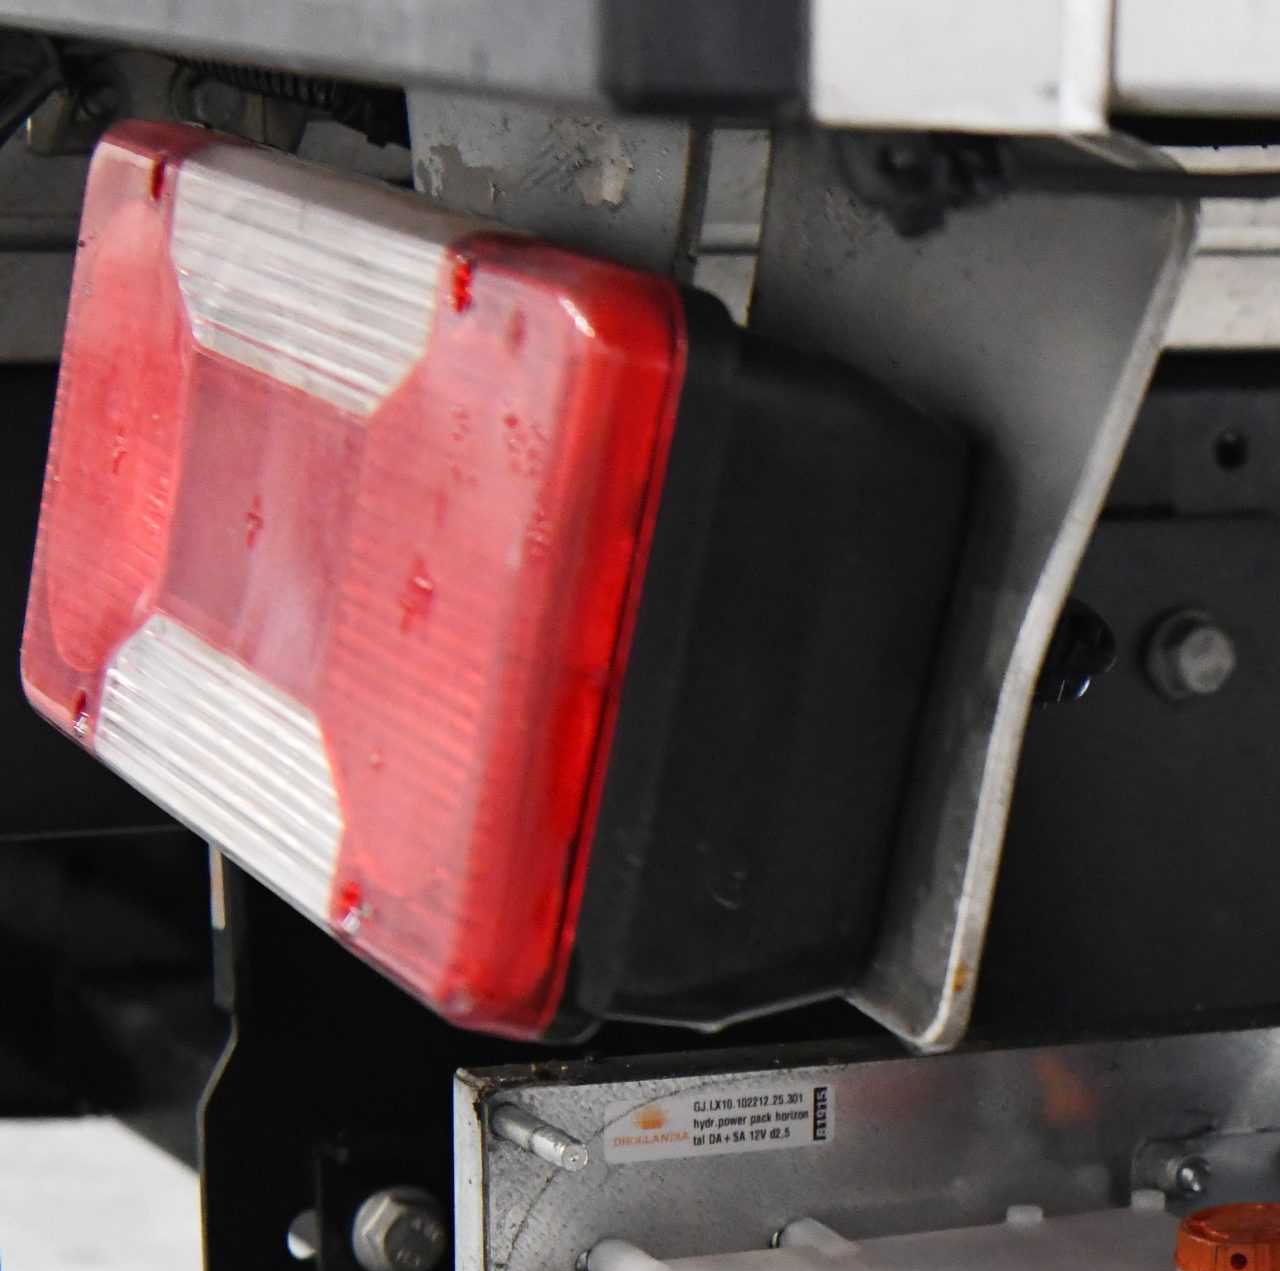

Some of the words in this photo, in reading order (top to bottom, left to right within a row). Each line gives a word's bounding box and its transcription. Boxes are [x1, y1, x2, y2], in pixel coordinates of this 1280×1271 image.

[750, 1112, 772, 1126] pack
[775, 1110, 809, 1122] horizon
[750, 1129, 767, 1141] 12V
